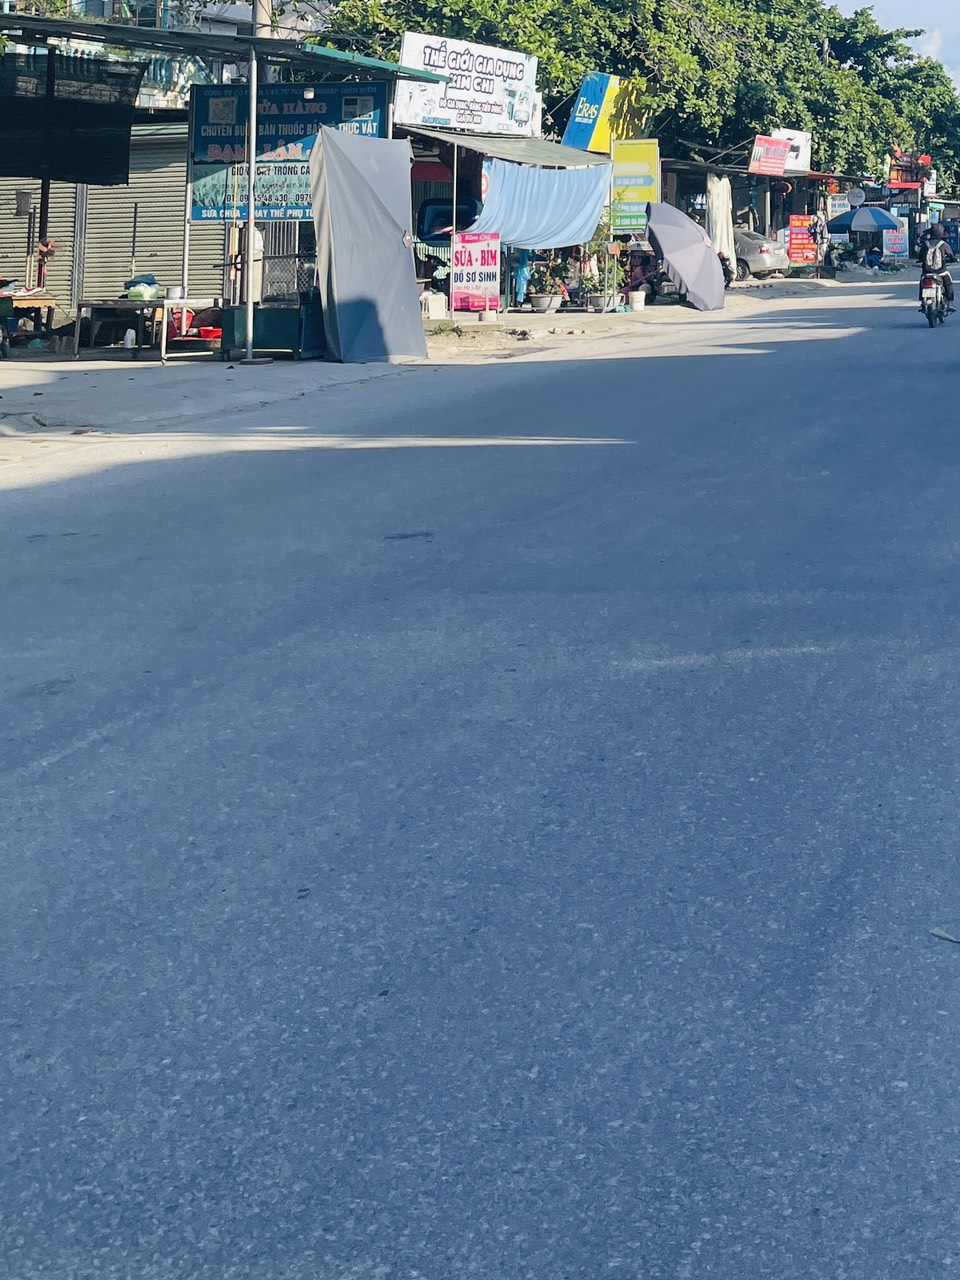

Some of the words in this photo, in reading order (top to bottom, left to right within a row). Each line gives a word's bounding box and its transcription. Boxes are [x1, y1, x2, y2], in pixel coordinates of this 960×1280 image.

[423, 40, 448, 69] THẾ
[447, 47, 474, 73] GIỚI
[475, 55, 494, 76] GIA
[494, 58, 525, 83] DỤNG
[448, 73, 472, 91] KIM
[472, 76, 495, 95] CHI
[574, 96, 600, 119] ERAS
[454, 245, 473, 267] SỮA
[480, 242, 498, 267] BỈM
[478, 271, 497, 283] SINH
